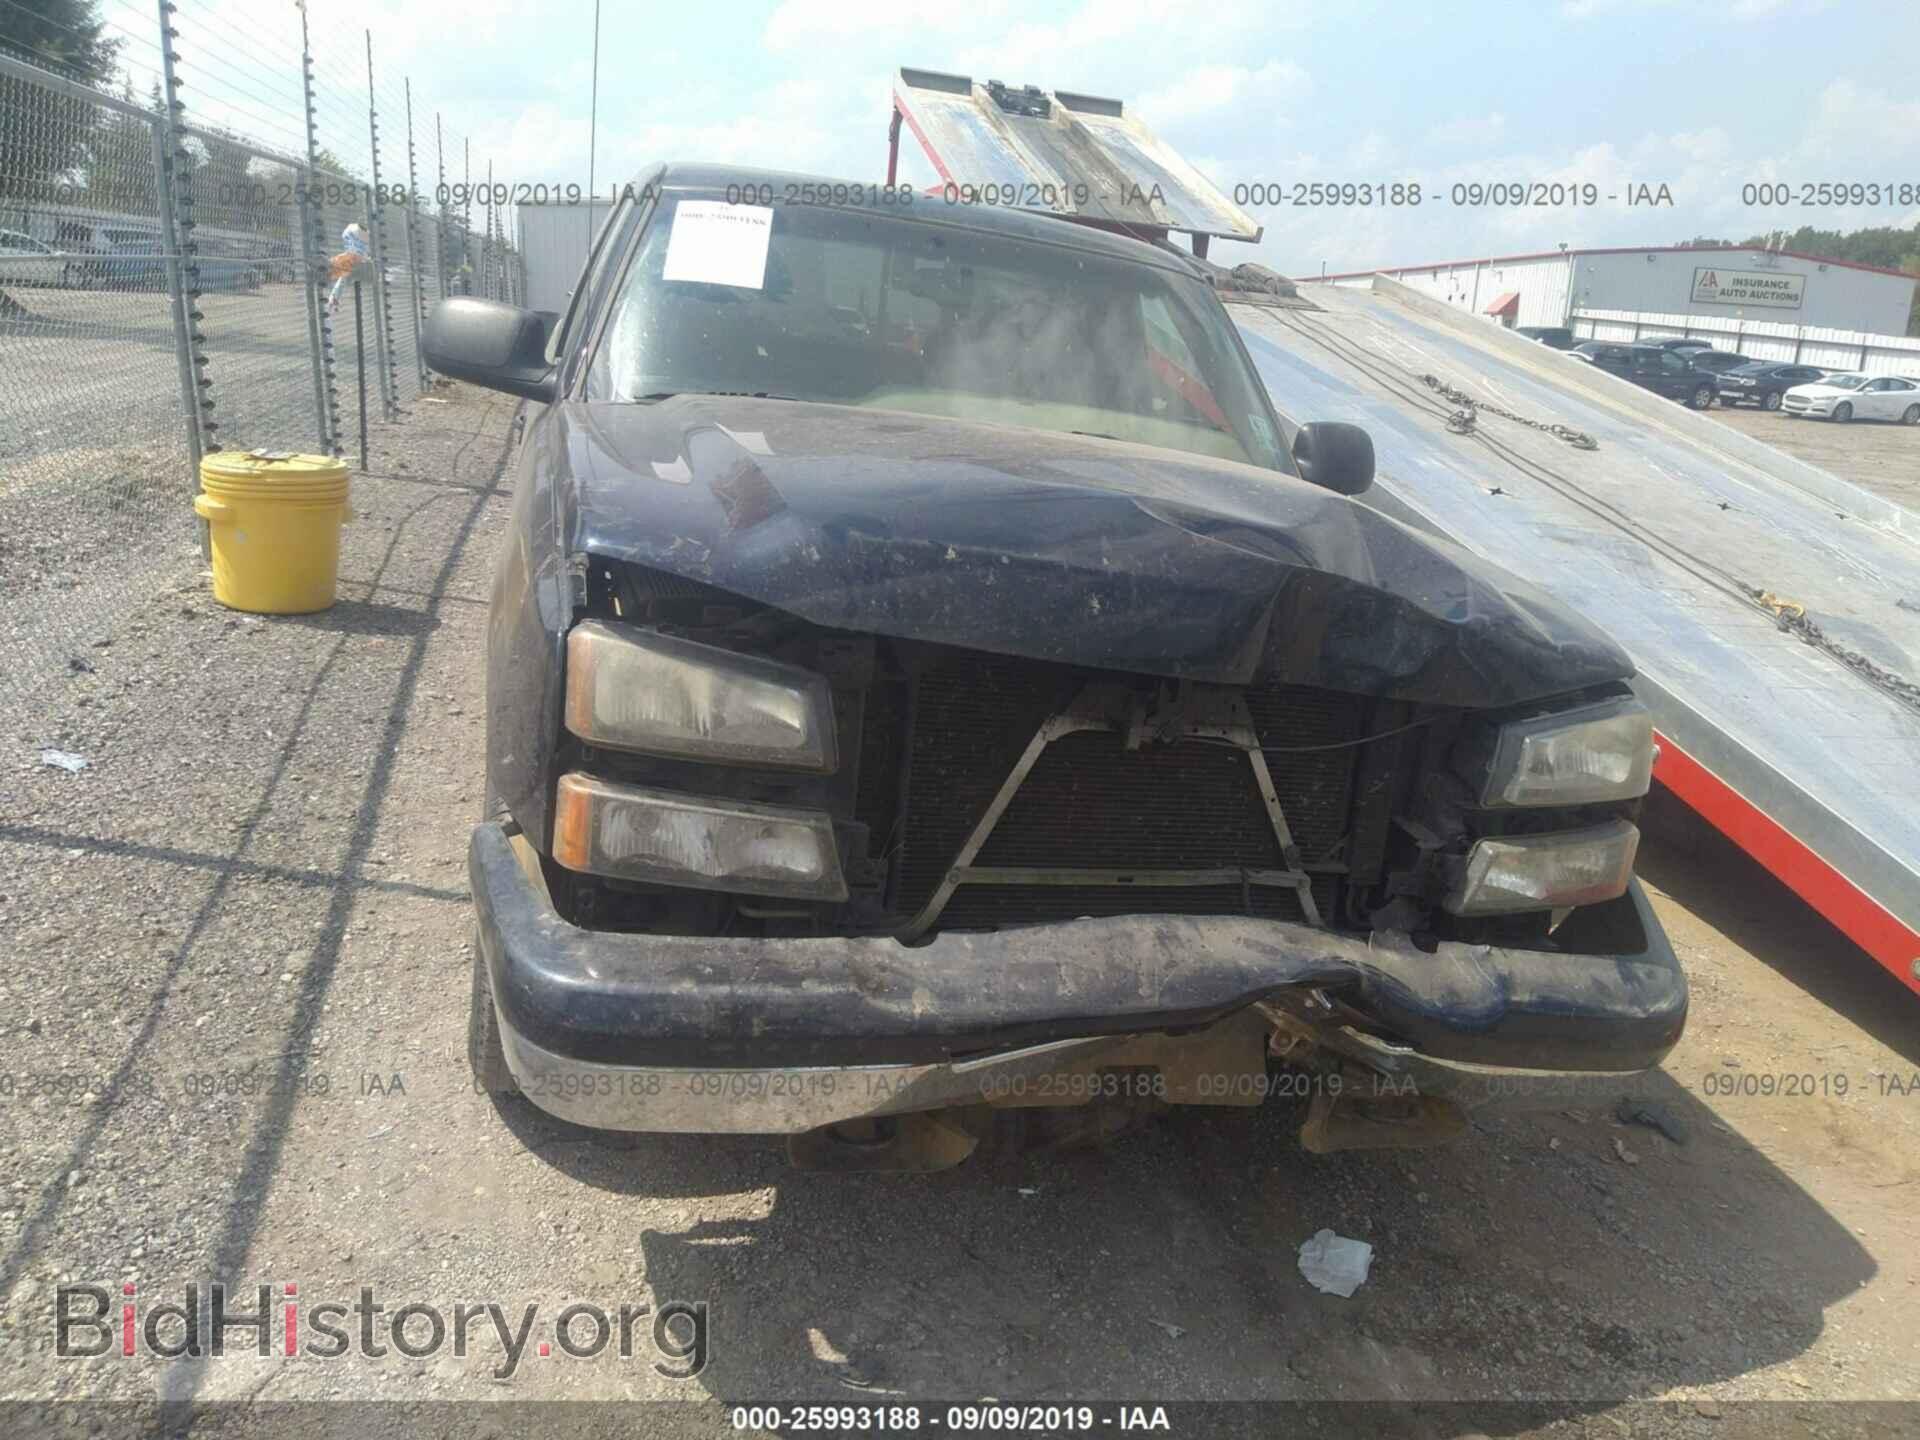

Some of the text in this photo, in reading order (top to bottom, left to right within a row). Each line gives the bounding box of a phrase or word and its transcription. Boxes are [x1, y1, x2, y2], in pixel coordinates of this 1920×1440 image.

[1732, 277, 1790, 290] INSURANCE
[1719, 287, 1747, 298] AUTO
[1748, 290, 1800, 302] AUCTIONS
